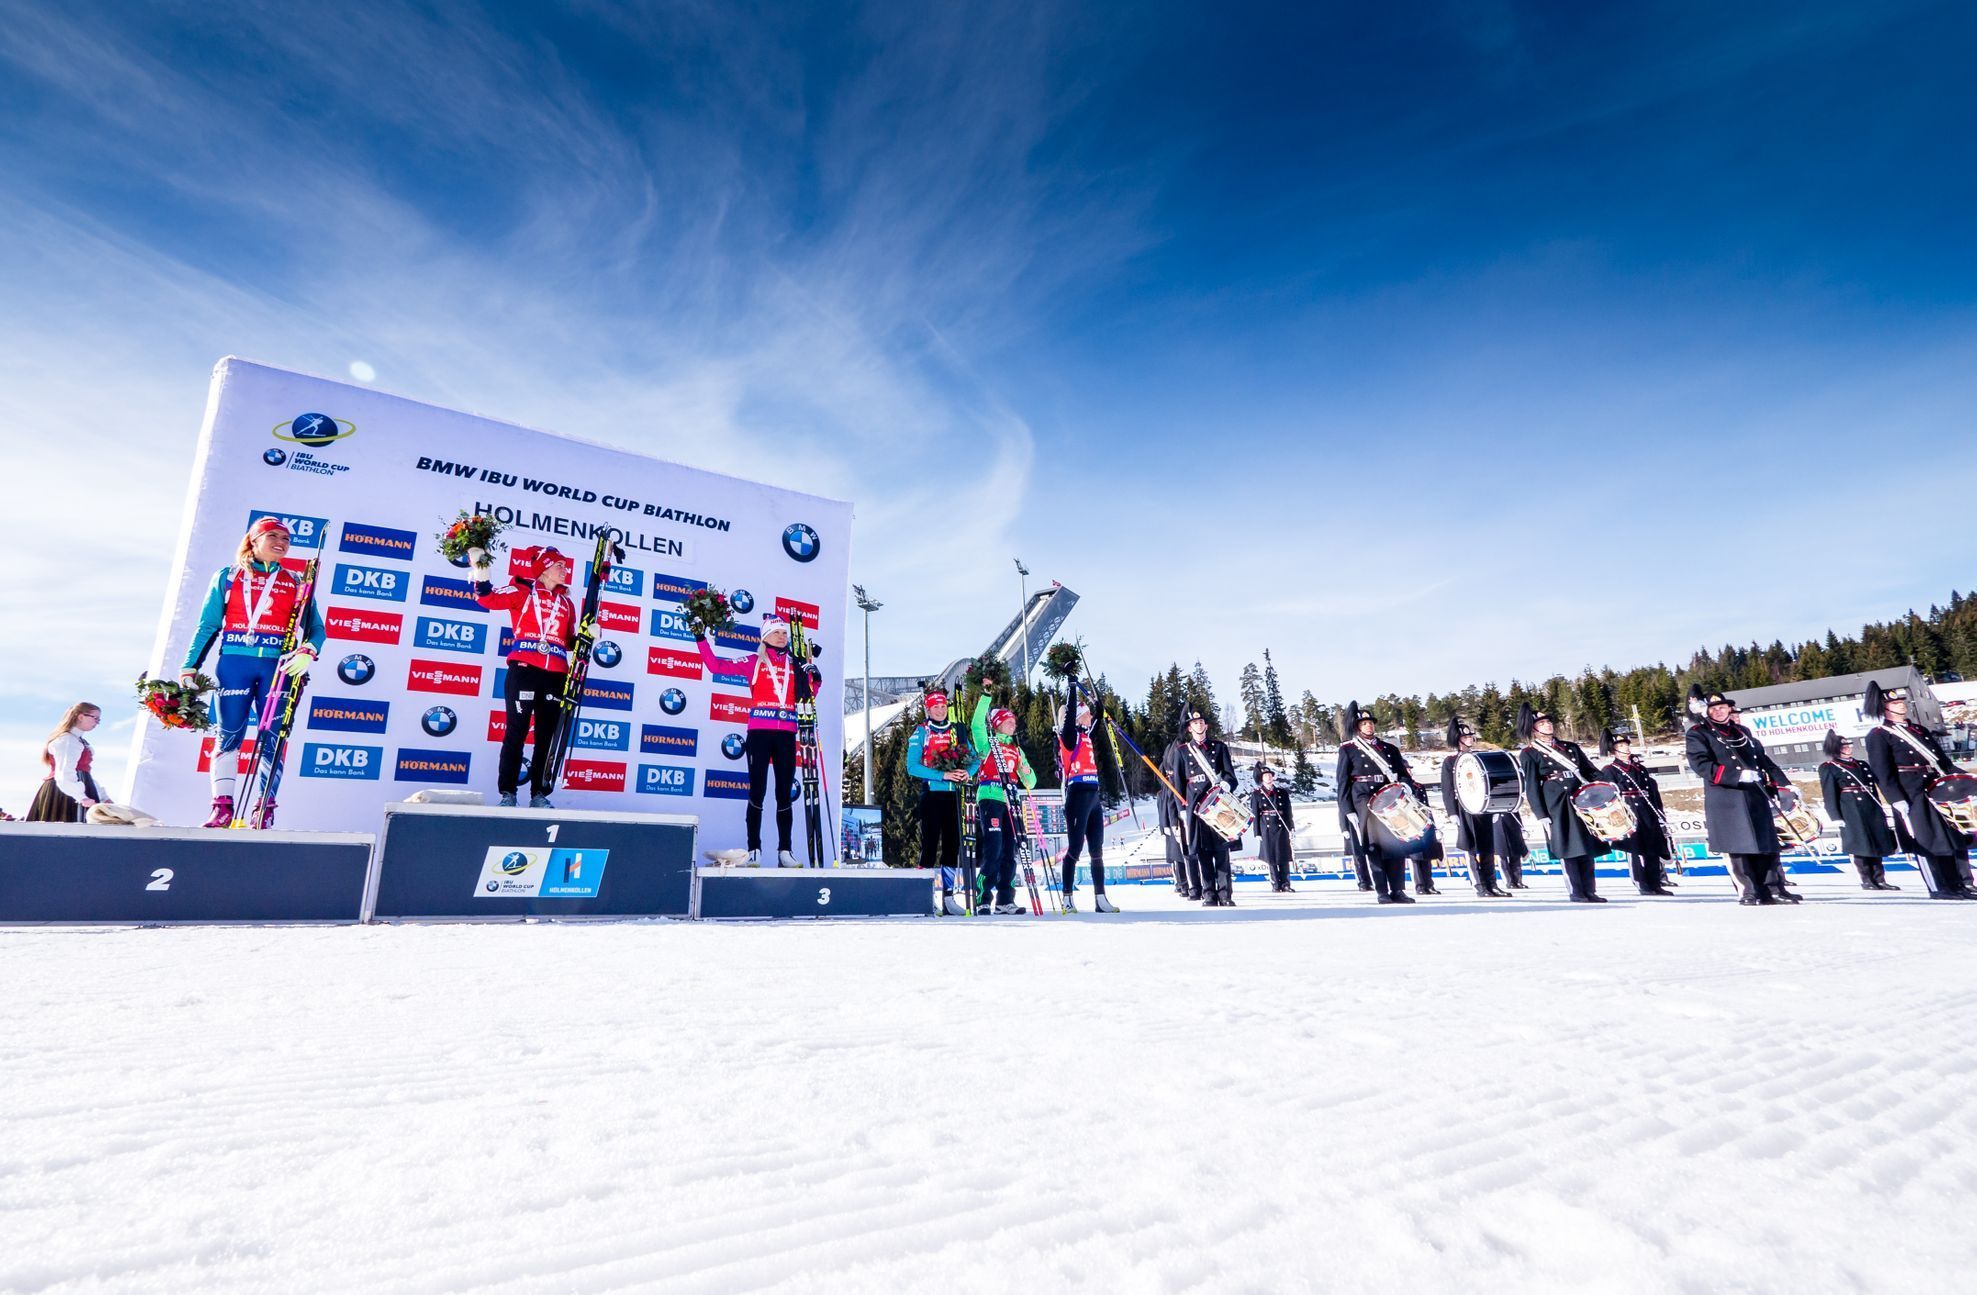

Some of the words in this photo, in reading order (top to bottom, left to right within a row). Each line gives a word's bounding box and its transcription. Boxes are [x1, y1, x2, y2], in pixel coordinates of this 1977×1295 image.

[296, 452, 313, 460] IBU
[291, 464, 335, 476] BIATHLON
[294, 458, 329, 469] WORLD
[331, 464, 350, 472] CUP
[416, 456, 478, 479] BMW
[480, 469, 518, 488] IBU
[523, 478, 597, 504] WORLD
[602, 495, 640, 512] CUP
[643, 504, 731, 532] BIATHLON
[474, 501, 683, 557] HOLMENKOLLEN
[345, 569, 396, 590] DKB
[606, 569, 634, 586] KB
[359, 587, 375, 595] kann
[377, 589, 393, 597] Bank
[425, 586, 479, 601] HÖRMAN
[328, 618, 400, 632] VIESSMANN
[427, 621, 475, 642] DKB
[441, 640, 455, 648] kann
[650, 656, 702, 669] VIESSMANN
[411, 670, 480, 685] VIESSMANN
[583, 687, 631, 701] ÖRMANN
[712, 702, 752, 715] VIESSMAN
[753, 709, 776, 718] BMW
[1753, 708, 1836, 730] WELCOME
[578, 722, 620, 740] DKB
[1754, 729, 1767, 738] TO
[1768, 722, 1838, 736] HOLMENKOLLEN!
[315, 747, 369, 768] DKB
[567, 768, 624, 782] VIESSMANN
[646, 768, 685, 786] DKB
[546, 824, 560, 843] 1
[145, 867, 174, 891] 2
[817, 888, 831, 905] 3
